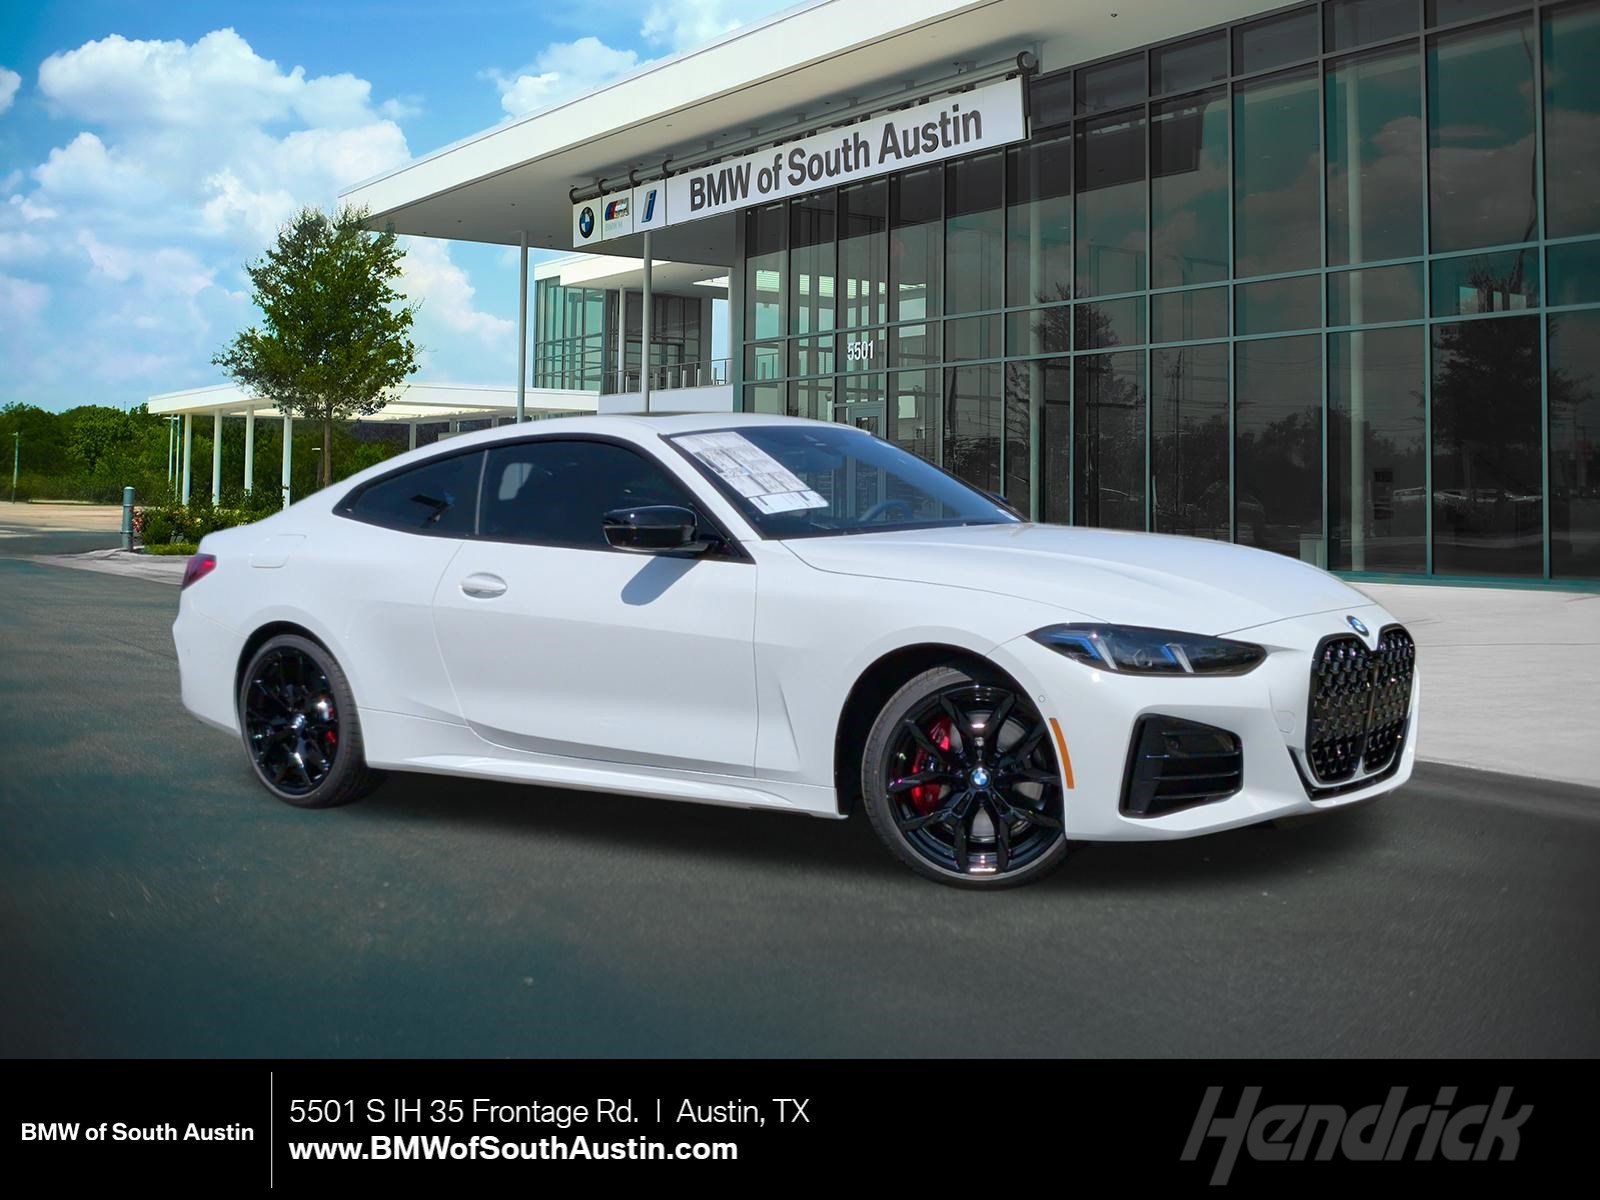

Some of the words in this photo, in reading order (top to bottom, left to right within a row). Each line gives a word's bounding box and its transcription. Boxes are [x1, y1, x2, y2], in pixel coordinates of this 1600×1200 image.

[690, 162, 752, 212] BMW
[757, 153, 783, 194] of
[787, 132, 871, 187] South
[878, 104, 983, 164] Austin
[847, 340, 874, 360] 5501
